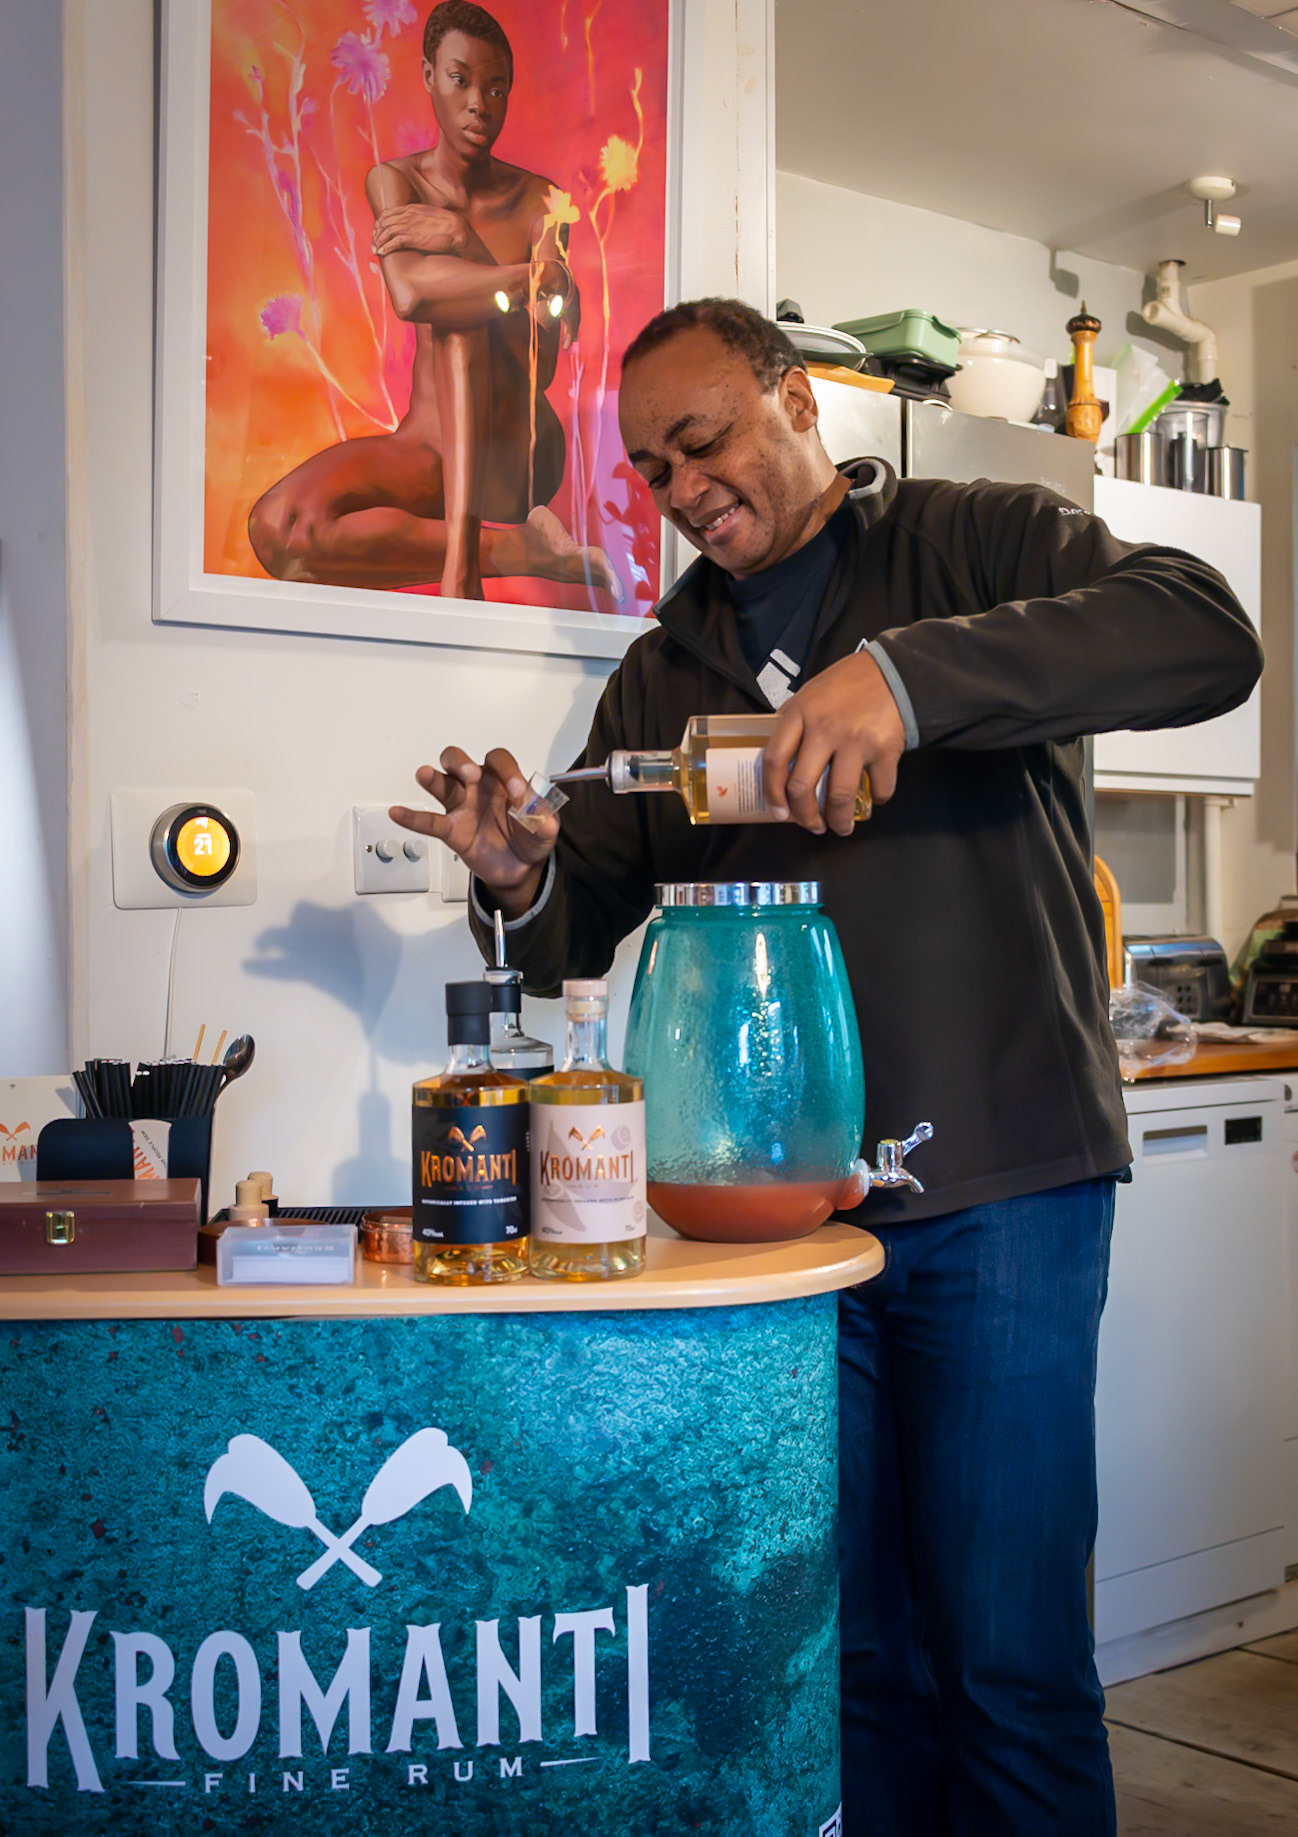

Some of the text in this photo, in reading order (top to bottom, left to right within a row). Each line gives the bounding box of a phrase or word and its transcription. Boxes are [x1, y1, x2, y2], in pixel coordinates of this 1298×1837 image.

[193, 838, 213, 856] 21
[421, 1148, 517, 1187] KROMANTI
[540, 1151, 636, 1187] KROMANTI
[25, 1583, 651, 1793] KROMANTI
[204, 1757, 523, 1794] FINE RUM
